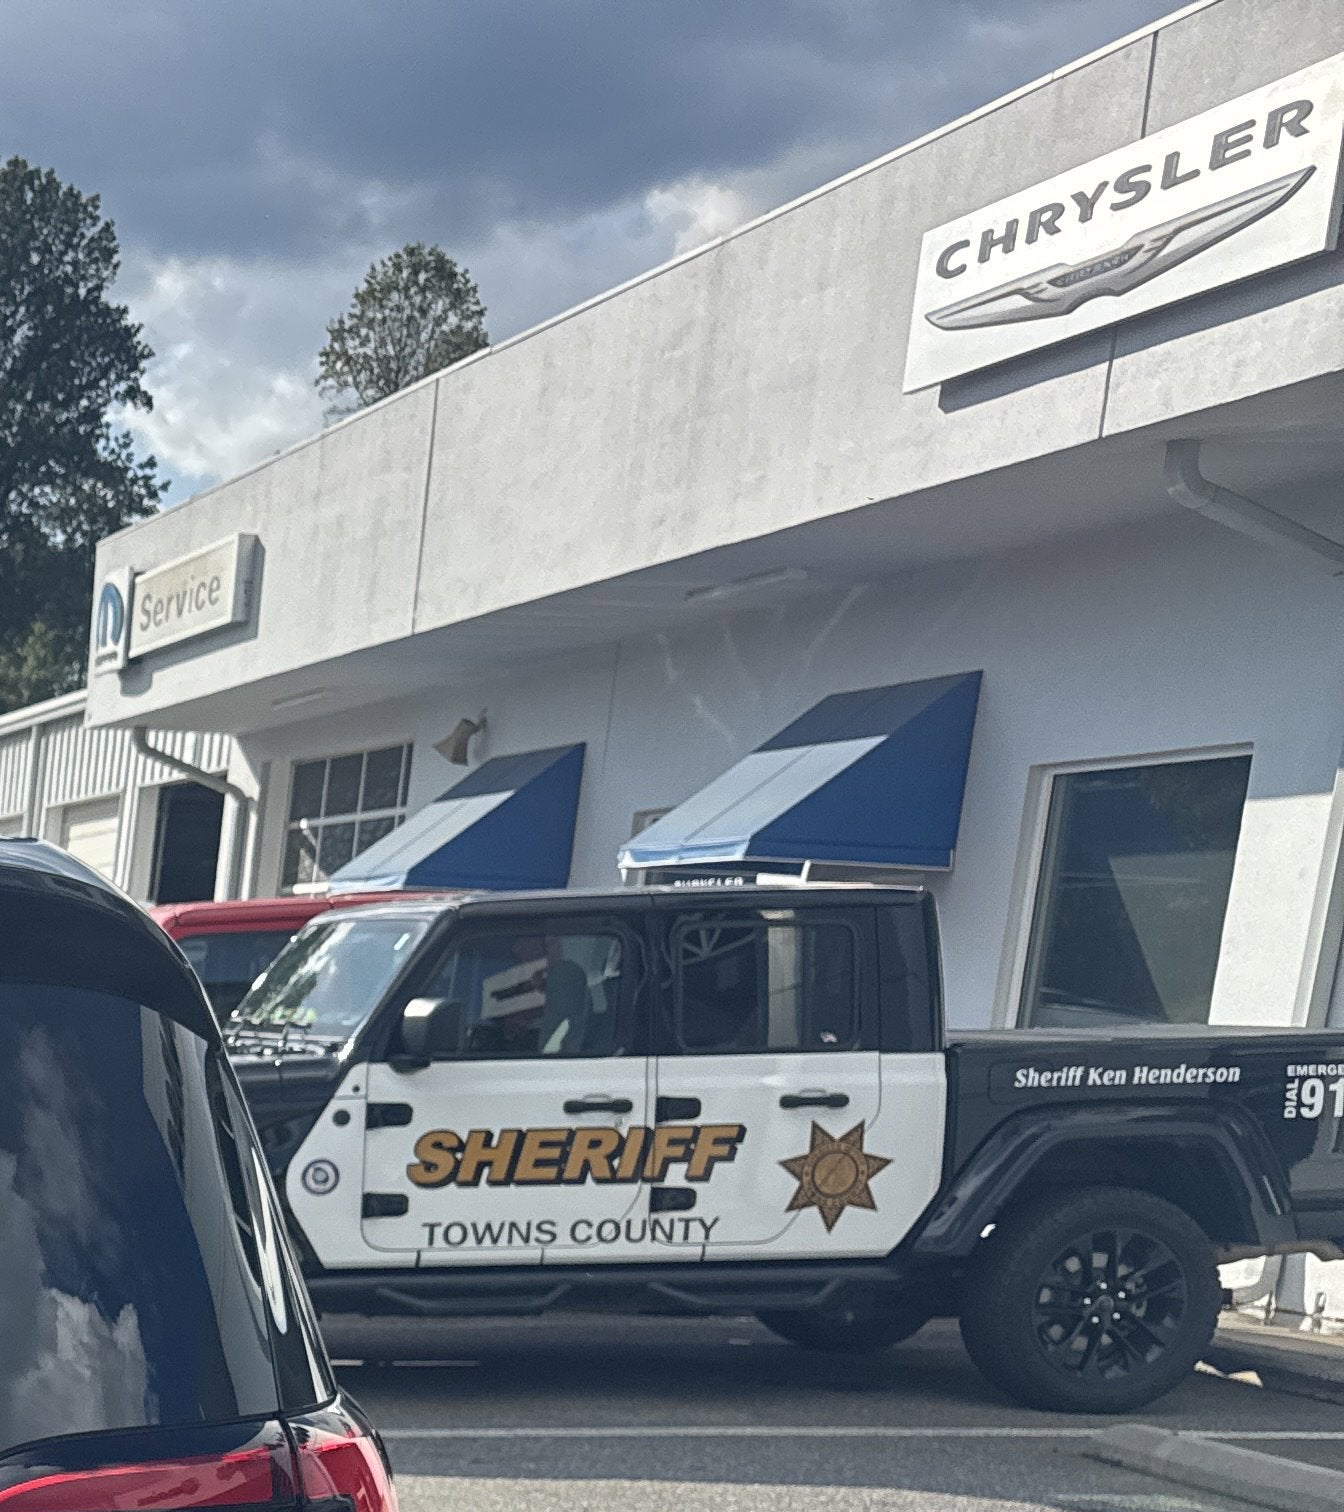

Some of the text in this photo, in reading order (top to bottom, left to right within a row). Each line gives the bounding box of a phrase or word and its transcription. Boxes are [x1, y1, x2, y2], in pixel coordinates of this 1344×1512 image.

[936, 99, 1315, 279] CHRYSLER
[139, 574, 222, 632] Service
[1014, 1063, 1241, 1088] Sheriff Ken Henderson
[1284, 1078, 1299, 1118] DIAL
[407, 1125, 747, 1188] SHERIFF
[422, 1216, 720, 1248] TOWNS COUNTY
